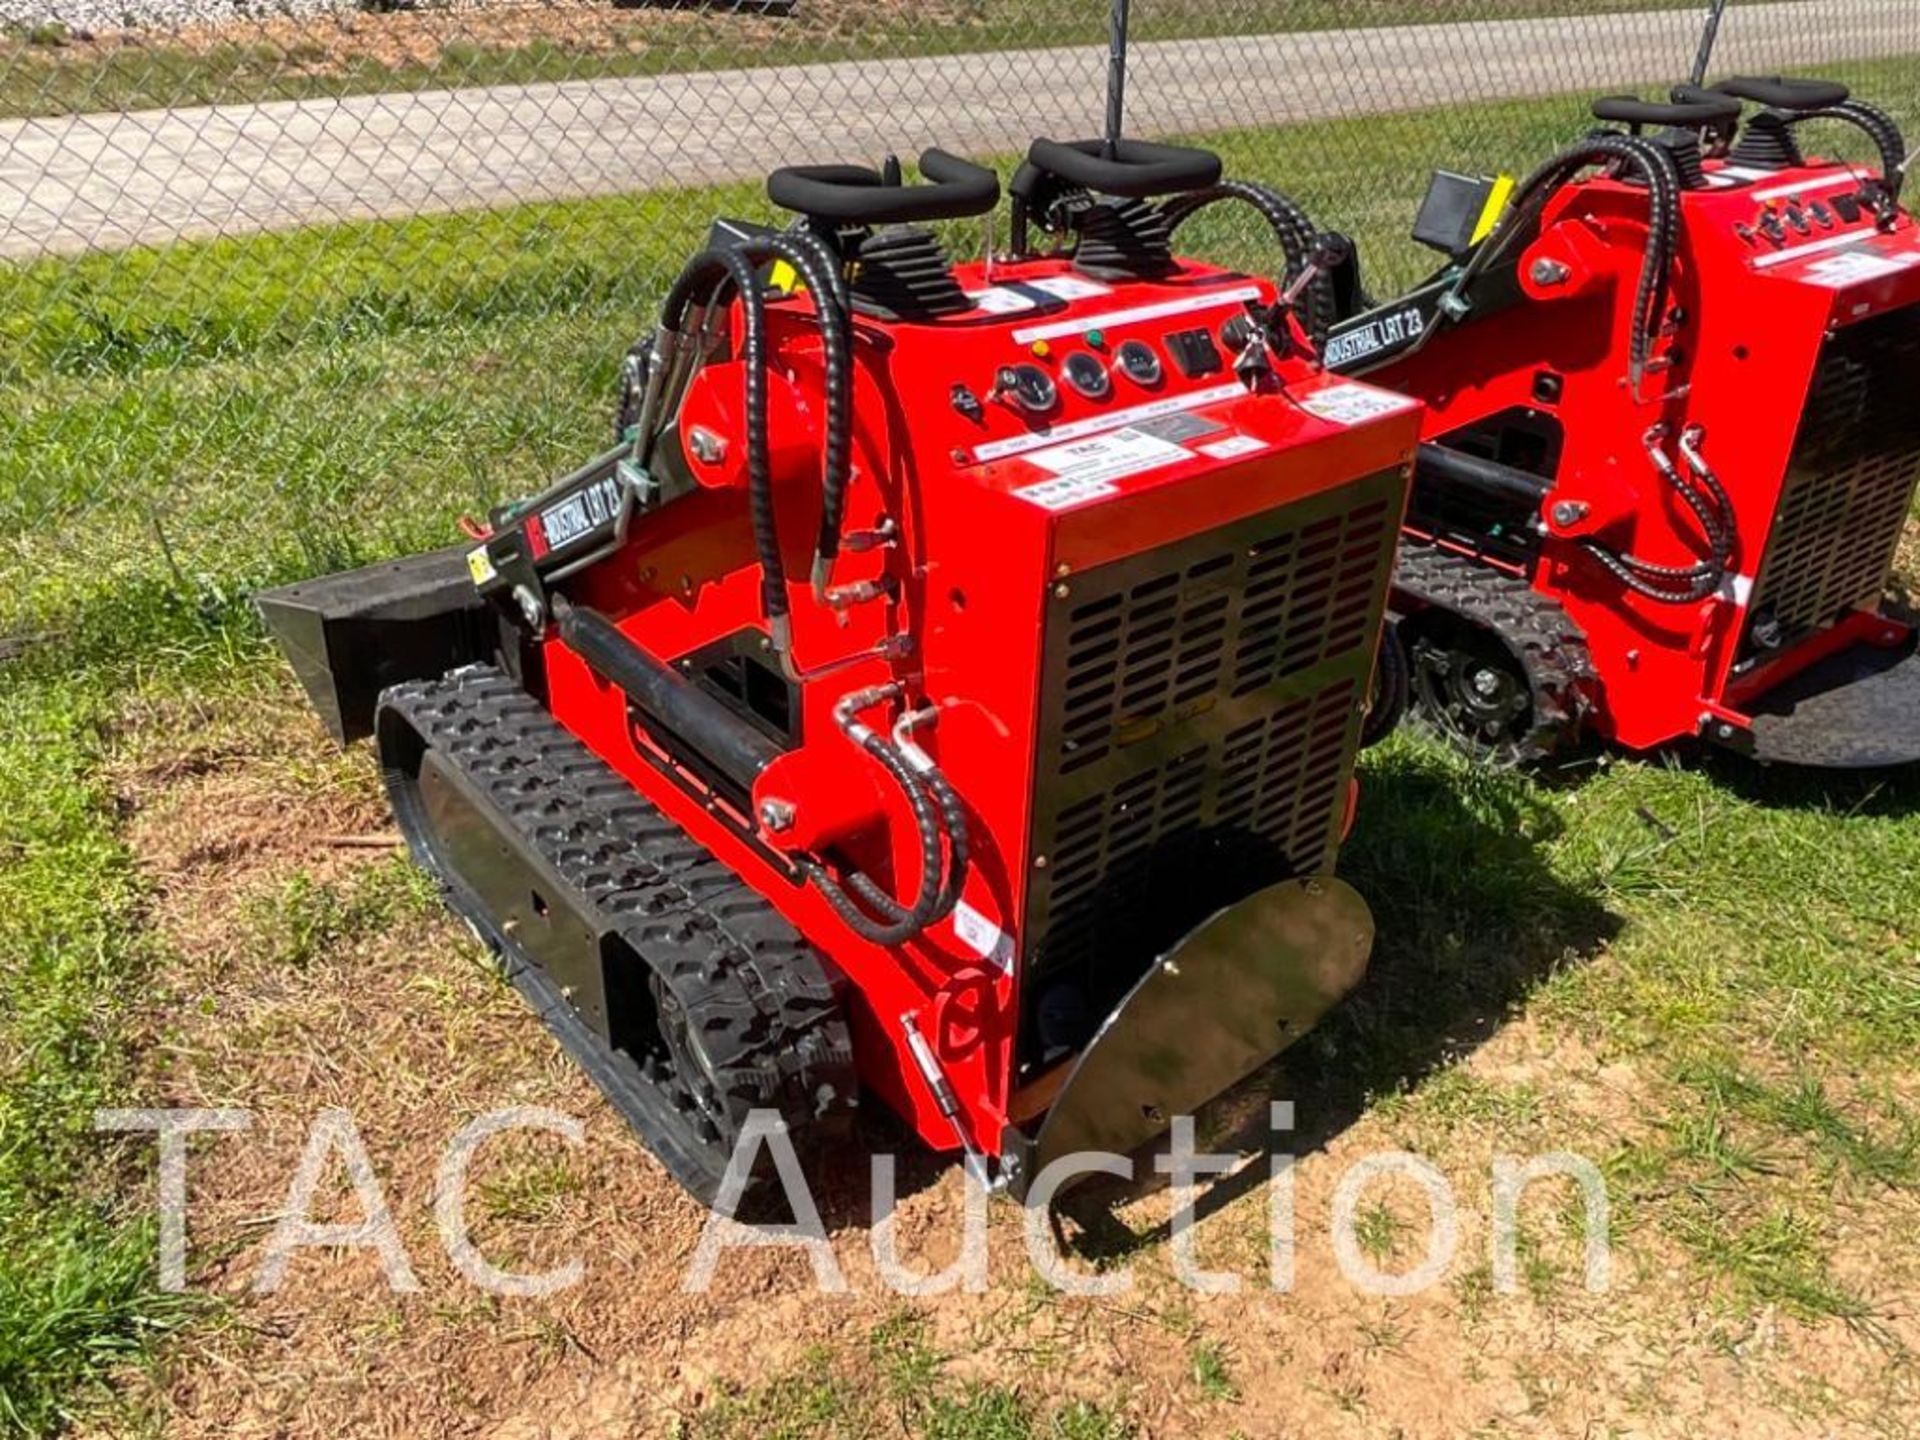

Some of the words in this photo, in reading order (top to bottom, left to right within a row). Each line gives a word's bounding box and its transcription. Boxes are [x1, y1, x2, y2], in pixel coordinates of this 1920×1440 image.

[1379, 313, 1404, 345] LRT
[1404, 308, 1423, 336] 23
[583, 483, 609, 526] LRT
[603, 477, 622, 517] 23
